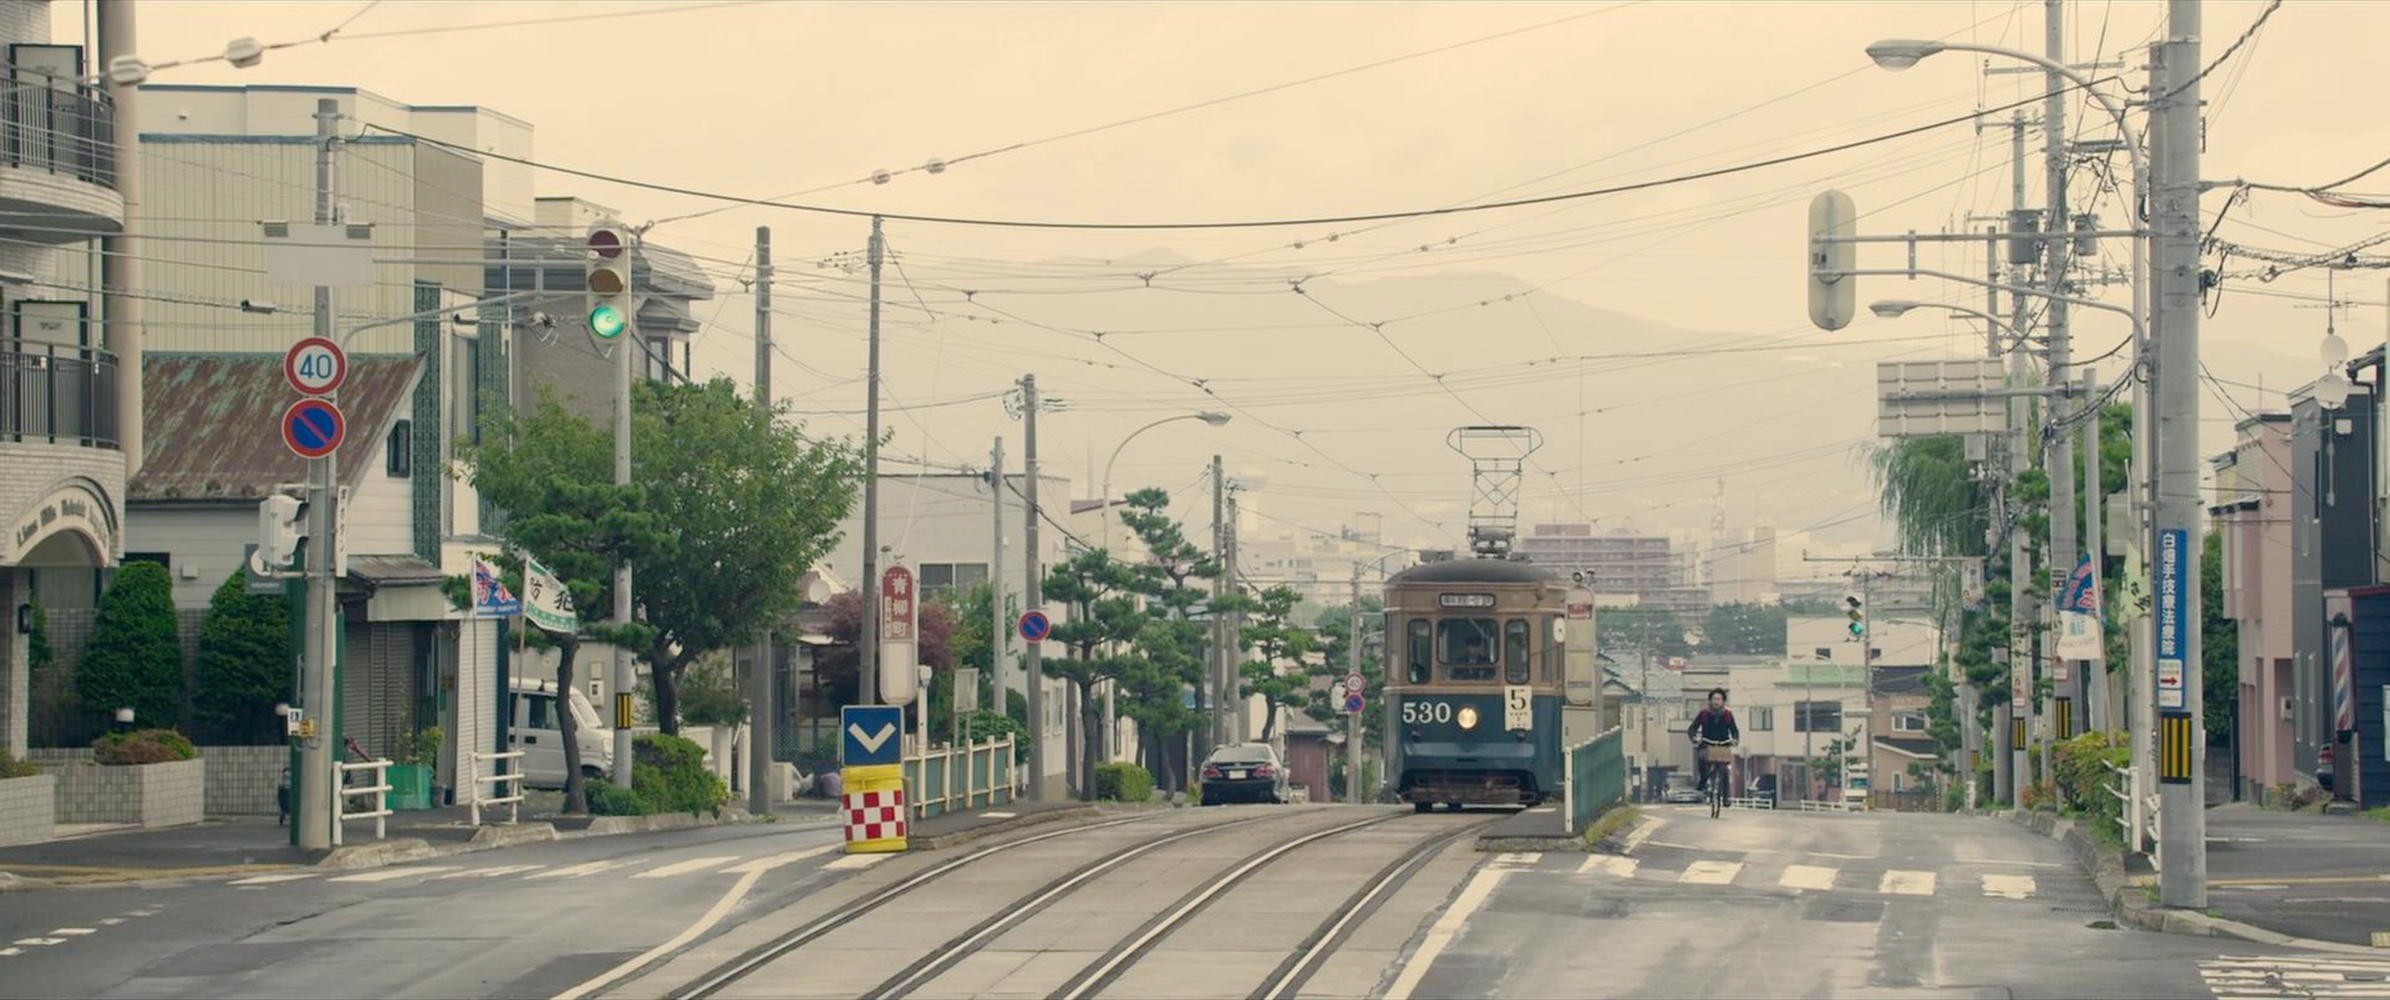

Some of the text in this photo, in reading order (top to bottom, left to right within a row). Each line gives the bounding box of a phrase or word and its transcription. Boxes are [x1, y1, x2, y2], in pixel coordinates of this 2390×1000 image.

[299, 353, 332, 379] 40
[891, 577, 908, 637] 青柳町
[1509, 688, 1526, 710] 5
[1402, 701, 1451, 724] 530
